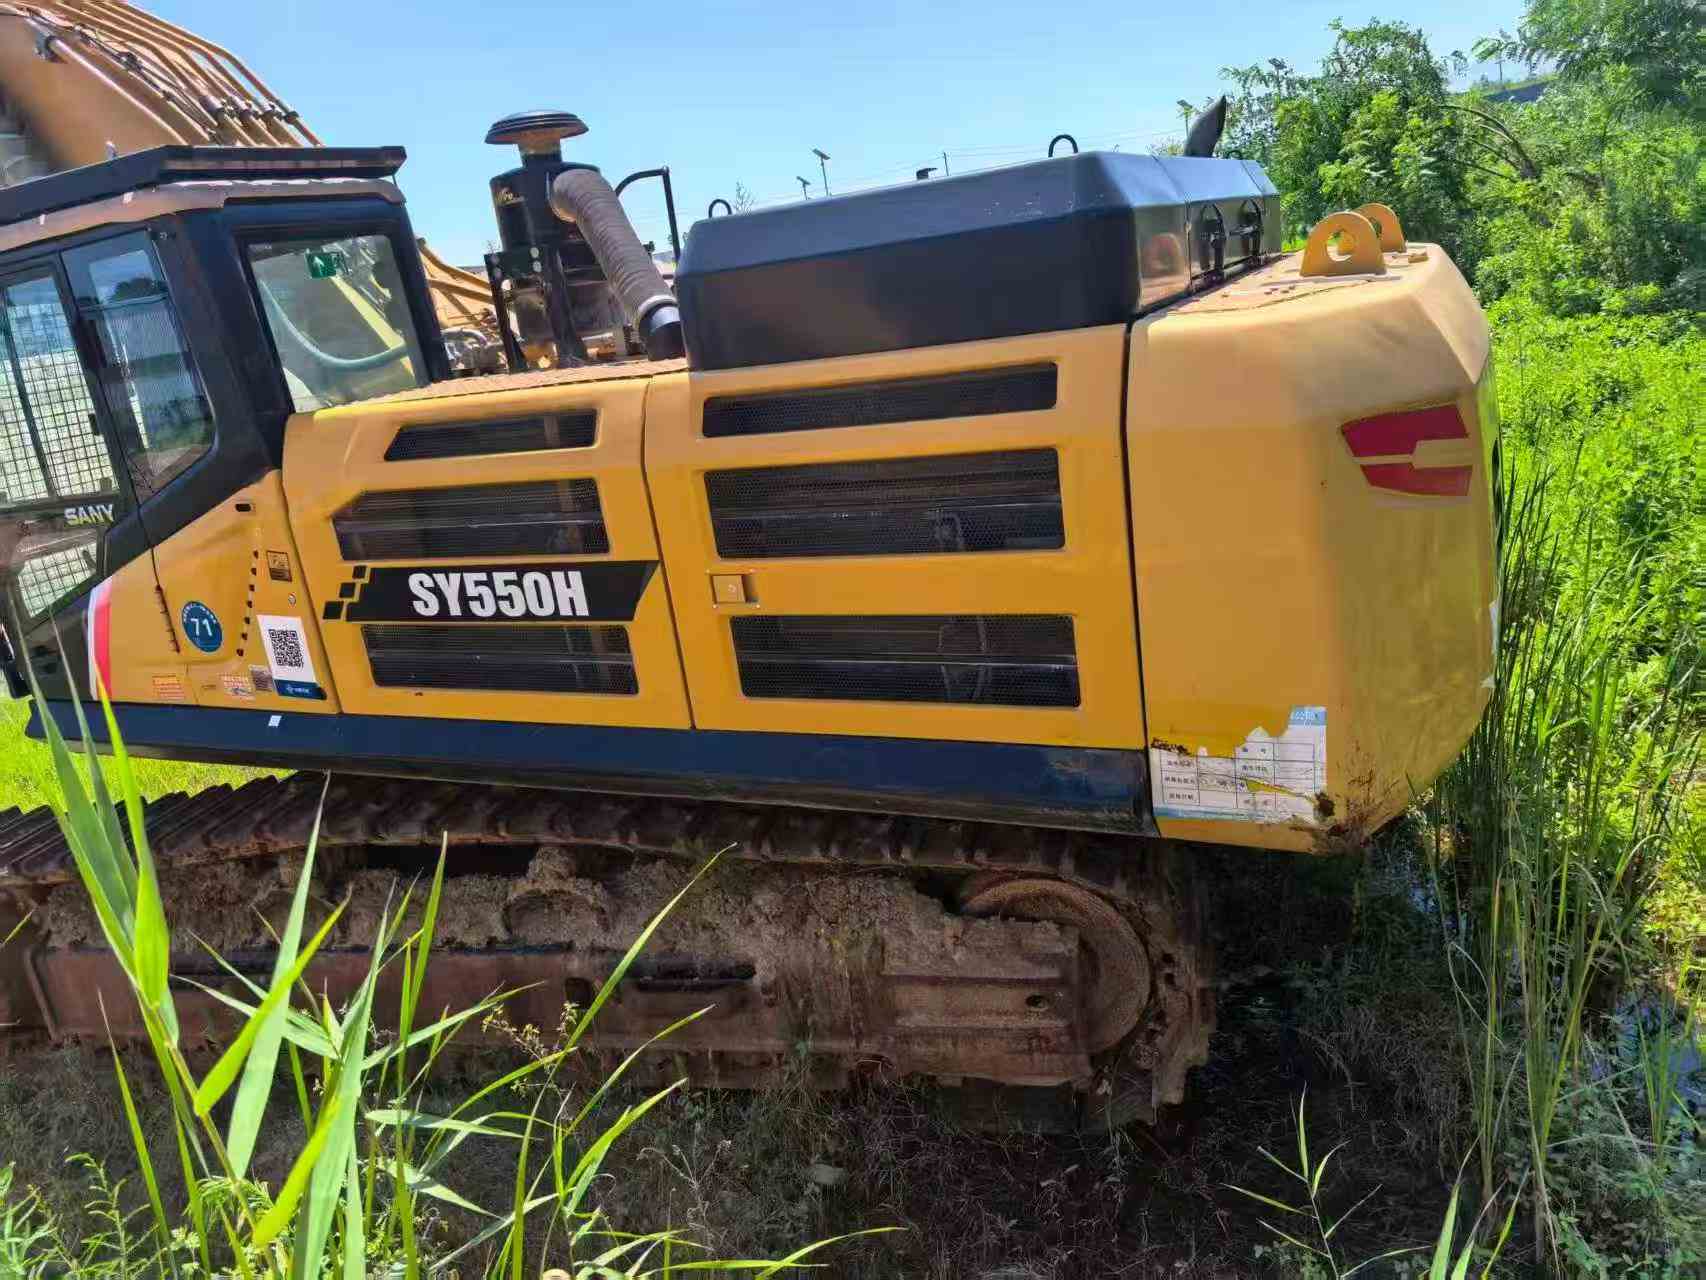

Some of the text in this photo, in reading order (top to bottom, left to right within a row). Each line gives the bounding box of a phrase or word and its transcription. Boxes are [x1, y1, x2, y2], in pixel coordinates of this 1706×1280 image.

[64, 504, 114, 526] SANY
[407, 570, 590, 617] SY550H
[190, 617, 213, 637] 71
